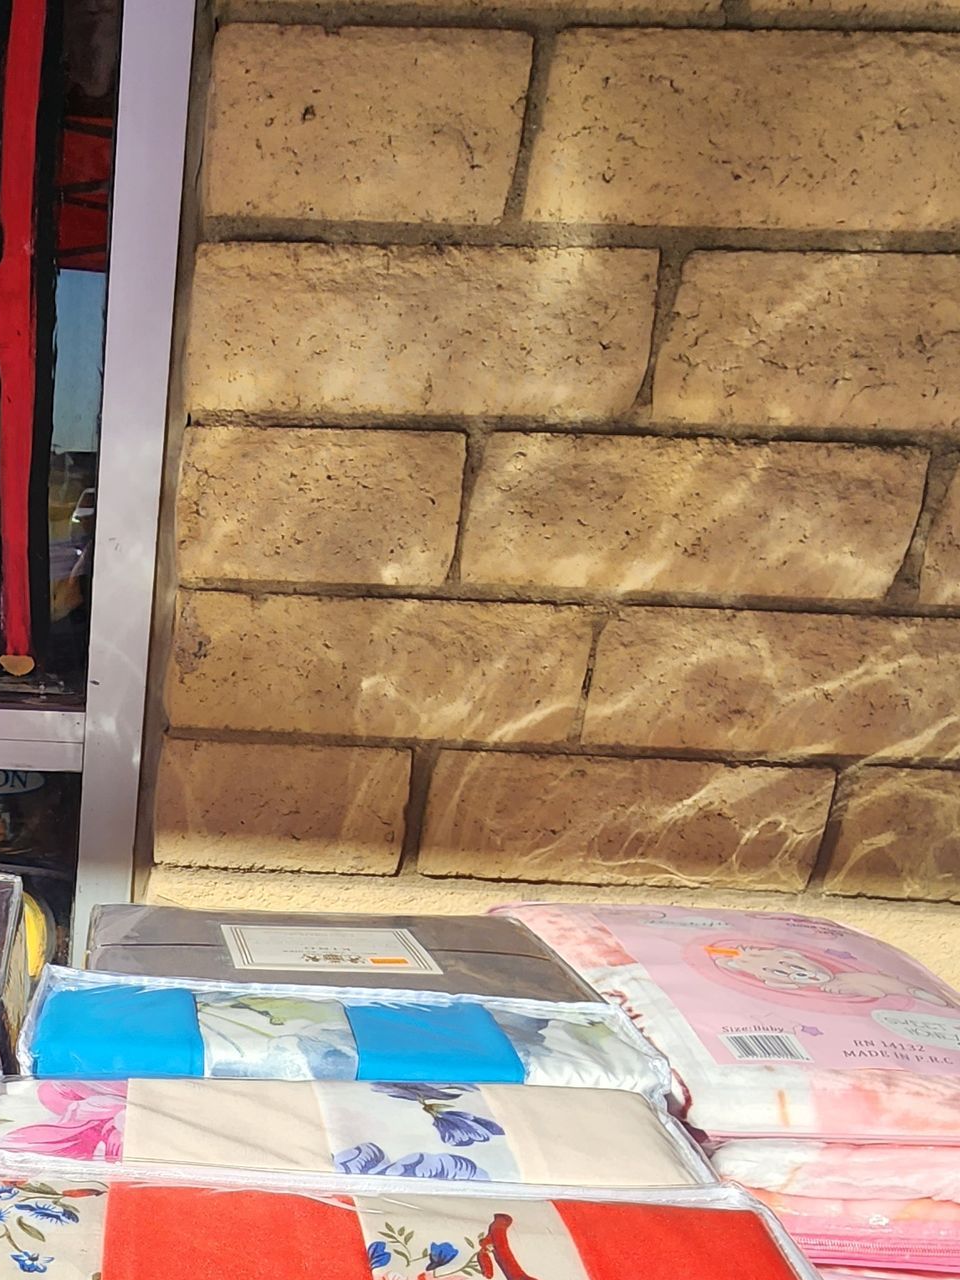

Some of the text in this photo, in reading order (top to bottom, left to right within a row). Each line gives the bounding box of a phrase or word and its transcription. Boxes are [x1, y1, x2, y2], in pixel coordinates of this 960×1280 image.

[853, 1040, 875, 1048] RN
[843, 1050, 890, 1059] MADE
[894, 1051, 910, 1061] IN
